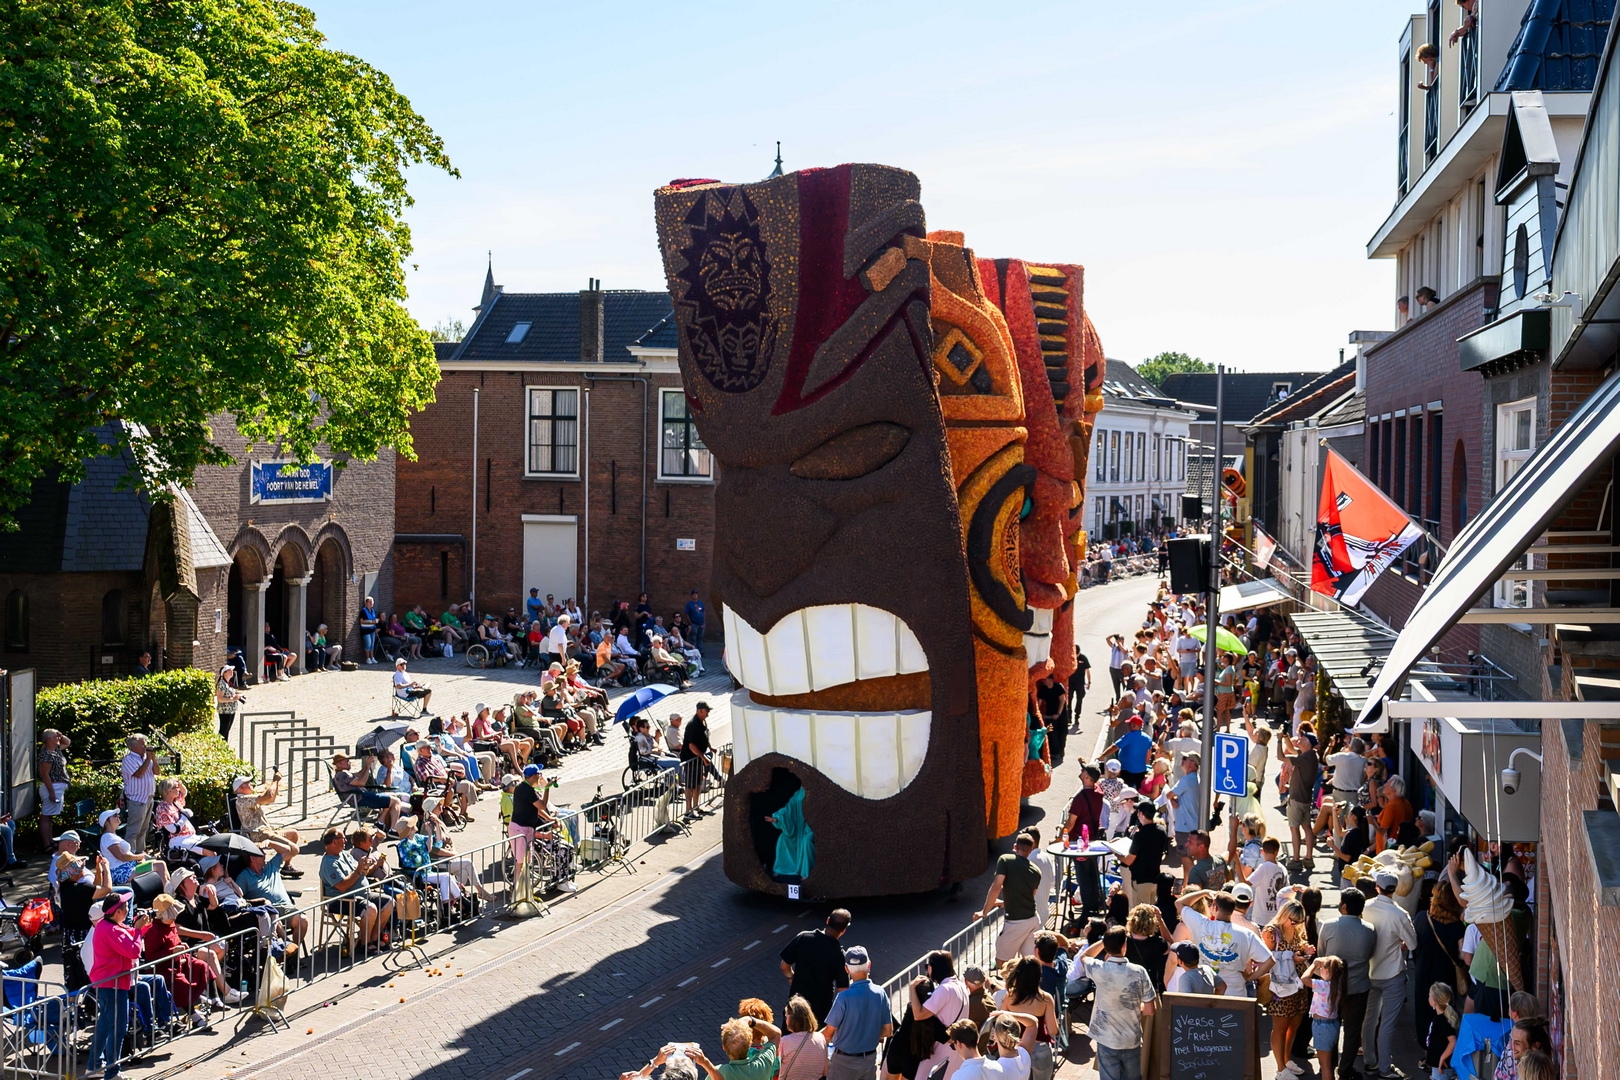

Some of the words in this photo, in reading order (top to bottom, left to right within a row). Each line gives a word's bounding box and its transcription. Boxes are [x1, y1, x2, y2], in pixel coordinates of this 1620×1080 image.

[300, 468, 310, 478] GOD
[266, 482, 283, 491] POORT
[284, 482, 294, 490] VAN
[295, 481, 302, 490] DE
[1222, 739, 1239, 768] P
[1175, 1045, 1191, 1055] met
